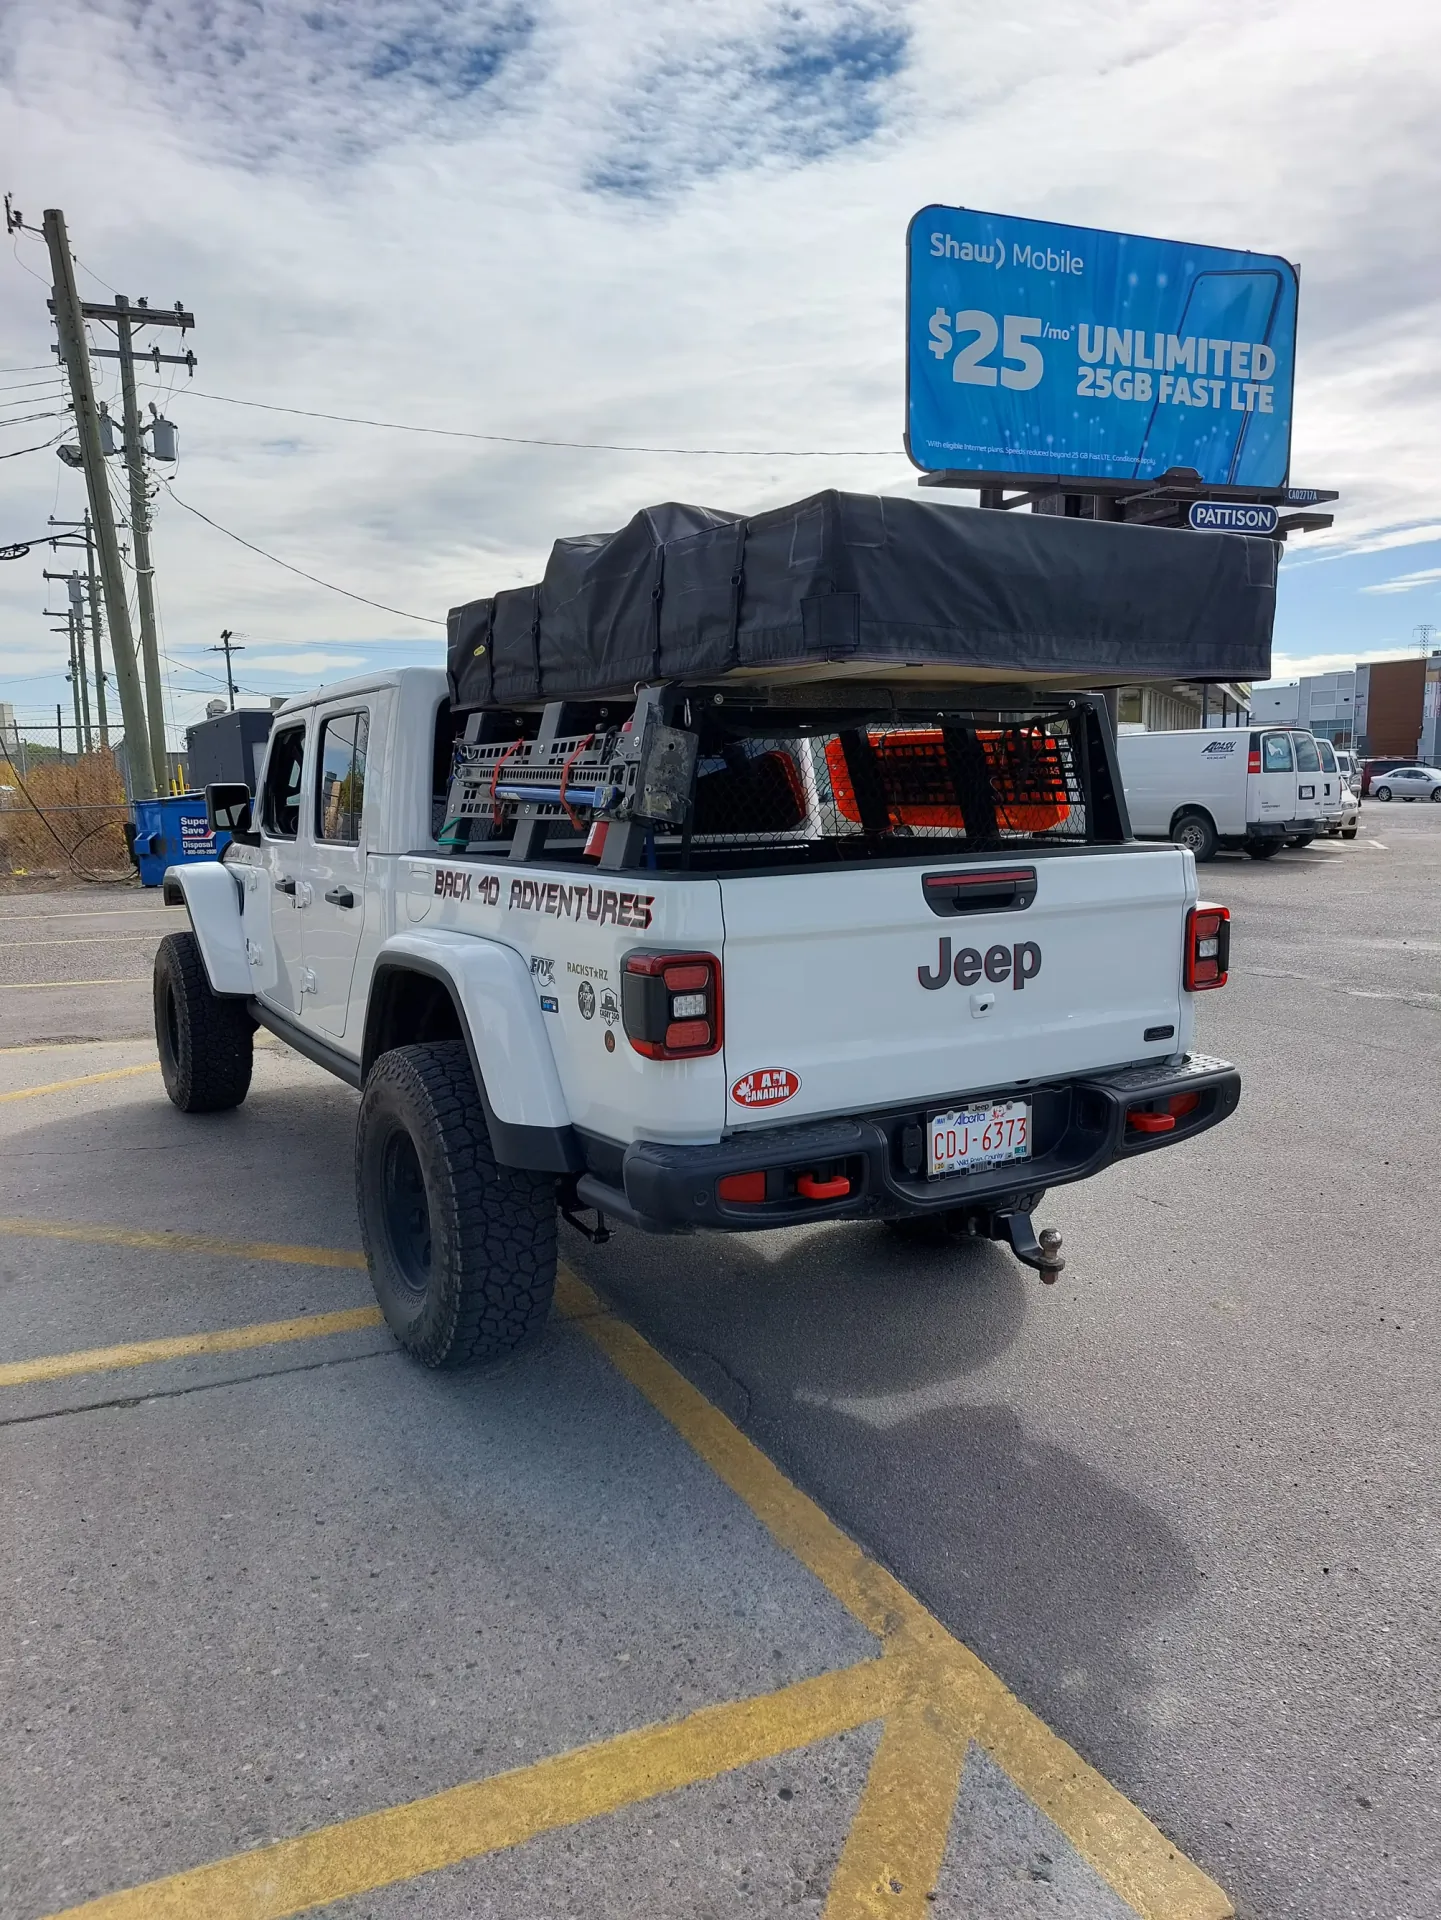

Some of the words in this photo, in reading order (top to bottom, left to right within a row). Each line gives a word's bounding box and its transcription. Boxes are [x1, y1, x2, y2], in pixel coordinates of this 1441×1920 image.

[1013, 243, 1084, 275] Mobile
[928, 307, 1044, 391] $25
[1077, 323, 1276, 381] UNLIMITED
[1076, 366, 1153, 402] 25GB
[1158, 374, 1226, 409] FAST
[1230, 381, 1275, 414] LTE
[963, 443, 987, 452] Internet
[1005, 446, 1026, 455] Speeds
[1026, 448, 1049, 457] reduced
[1049, 450, 1071, 459] beyond
[1112, 454, 1140, 464] Conditions
[1288, 489, 1317, 501] CA02717A
[1196, 507, 1272, 528] PATTISON
[181, 817, 208, 826] Super
[181, 826, 205, 834] Save
[182, 841, 213, 849] Disposal
[434, 869, 472, 902] BACK
[477, 875, 500, 906] 40
[508, 879, 656, 930] ADVENTURES
[918, 937, 1042, 990] Jeep
[761, 1071, 787, 1087] AM
[745, 1086, 790, 1103] CANADIAN
[971, 1104, 990, 1112] Jeep
[953, 1111, 986, 1126] Alberta
[934, 1117, 1027, 1160] CDJ-6373
[956, 1158, 969, 1167] Wild
[984, 1151, 1004, 1160] County
